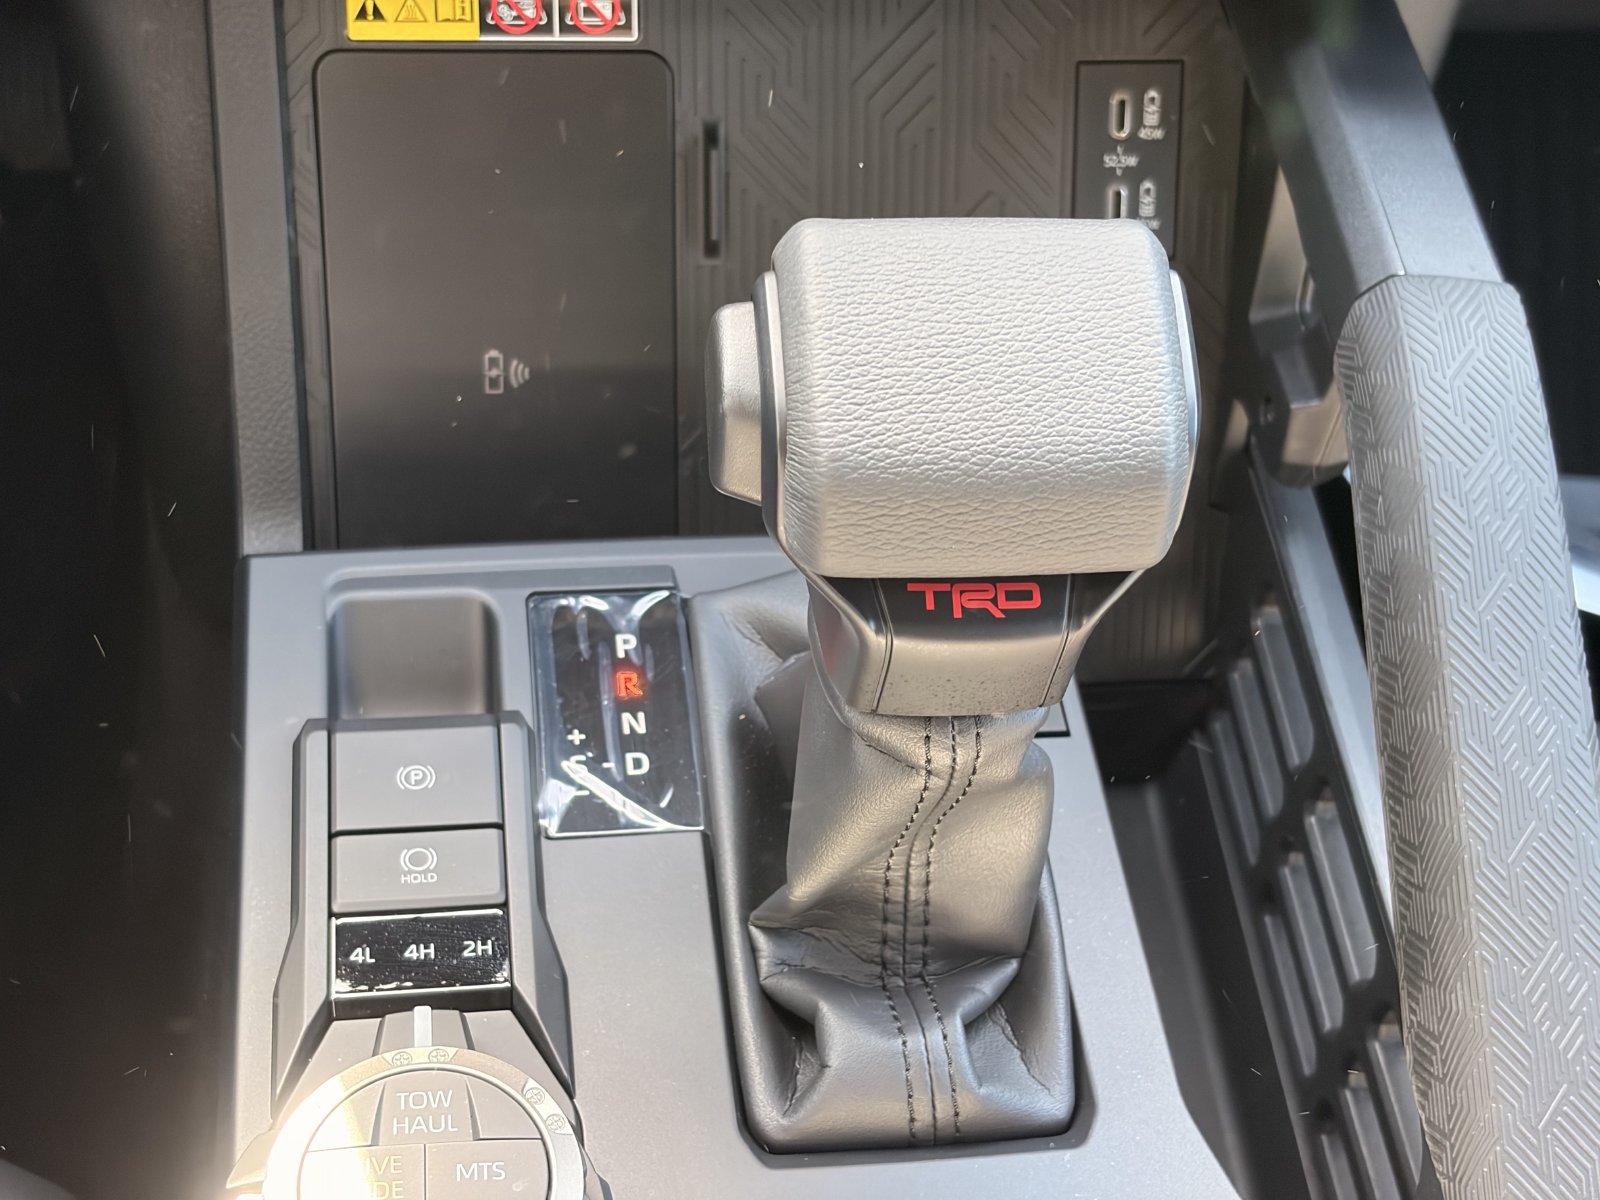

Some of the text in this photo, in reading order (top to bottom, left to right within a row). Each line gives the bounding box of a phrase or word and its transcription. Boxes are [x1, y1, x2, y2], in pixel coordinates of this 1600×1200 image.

[907, 583, 1041, 618] TRD
[614, 633, 637, 658] P
[616, 671, 643, 697] R
[621, 711, 647, 735] N
[625, 752, 650, 776] D
[401, 873, 438, 884] HOLD
[349, 940, 493, 964] 4L 4H 2H
[396, 1090, 453, 1109] TOW
[393, 1114, 458, 1135] HAUL
[456, 1162, 506, 1182] MTS
[371, 1180, 404, 1200] DE
